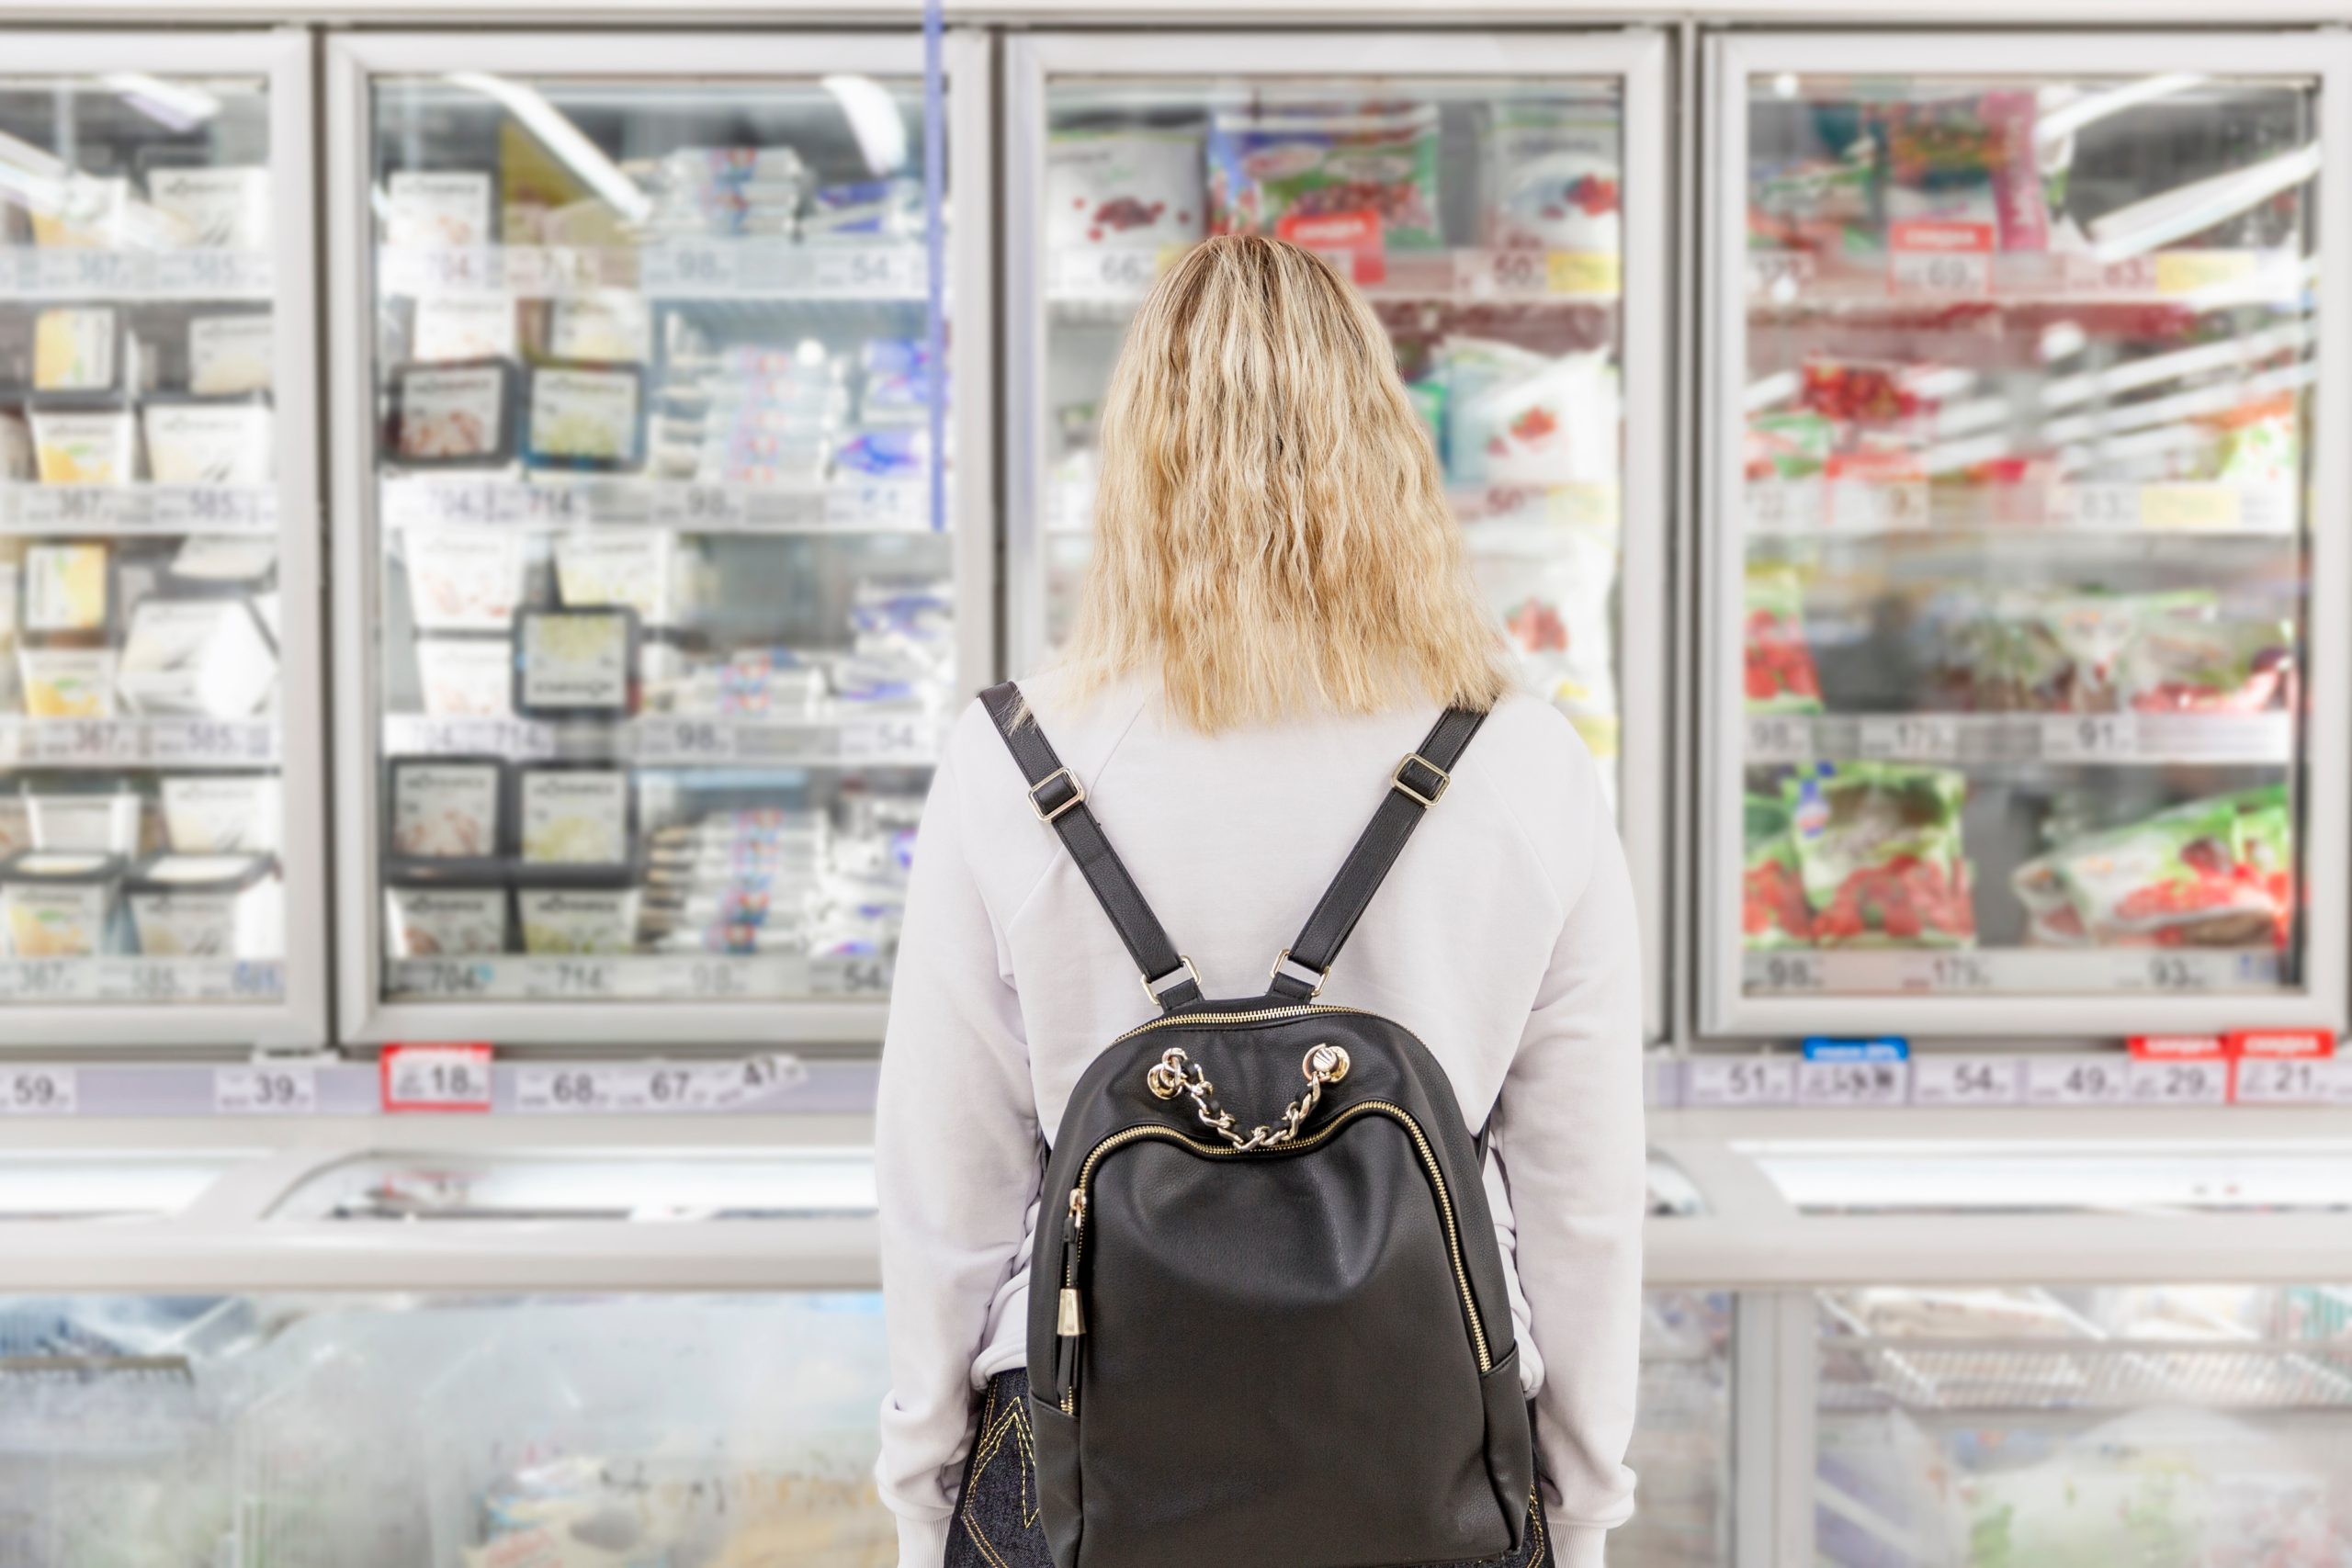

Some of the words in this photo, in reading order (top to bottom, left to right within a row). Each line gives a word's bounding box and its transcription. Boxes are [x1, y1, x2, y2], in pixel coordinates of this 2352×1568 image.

[675, 722, 715, 751] 98
[843, 964, 884, 991] 54
[15, 1077, 54, 1105] 59
[254, 1075, 296, 1104] 39
[432, 1066, 469, 1095] 18
[553, 1075, 594, 1104] 68
[650, 1071, 689, 1102] 67
[1729, 1064, 1764, 1093] 51
[1954, 1063, 1994, 1093] 54
[2065, 1066, 2106, 1095] 49
[2165, 1066, 2205, 1097] 29
[2275, 1064, 2312, 1093] 21
